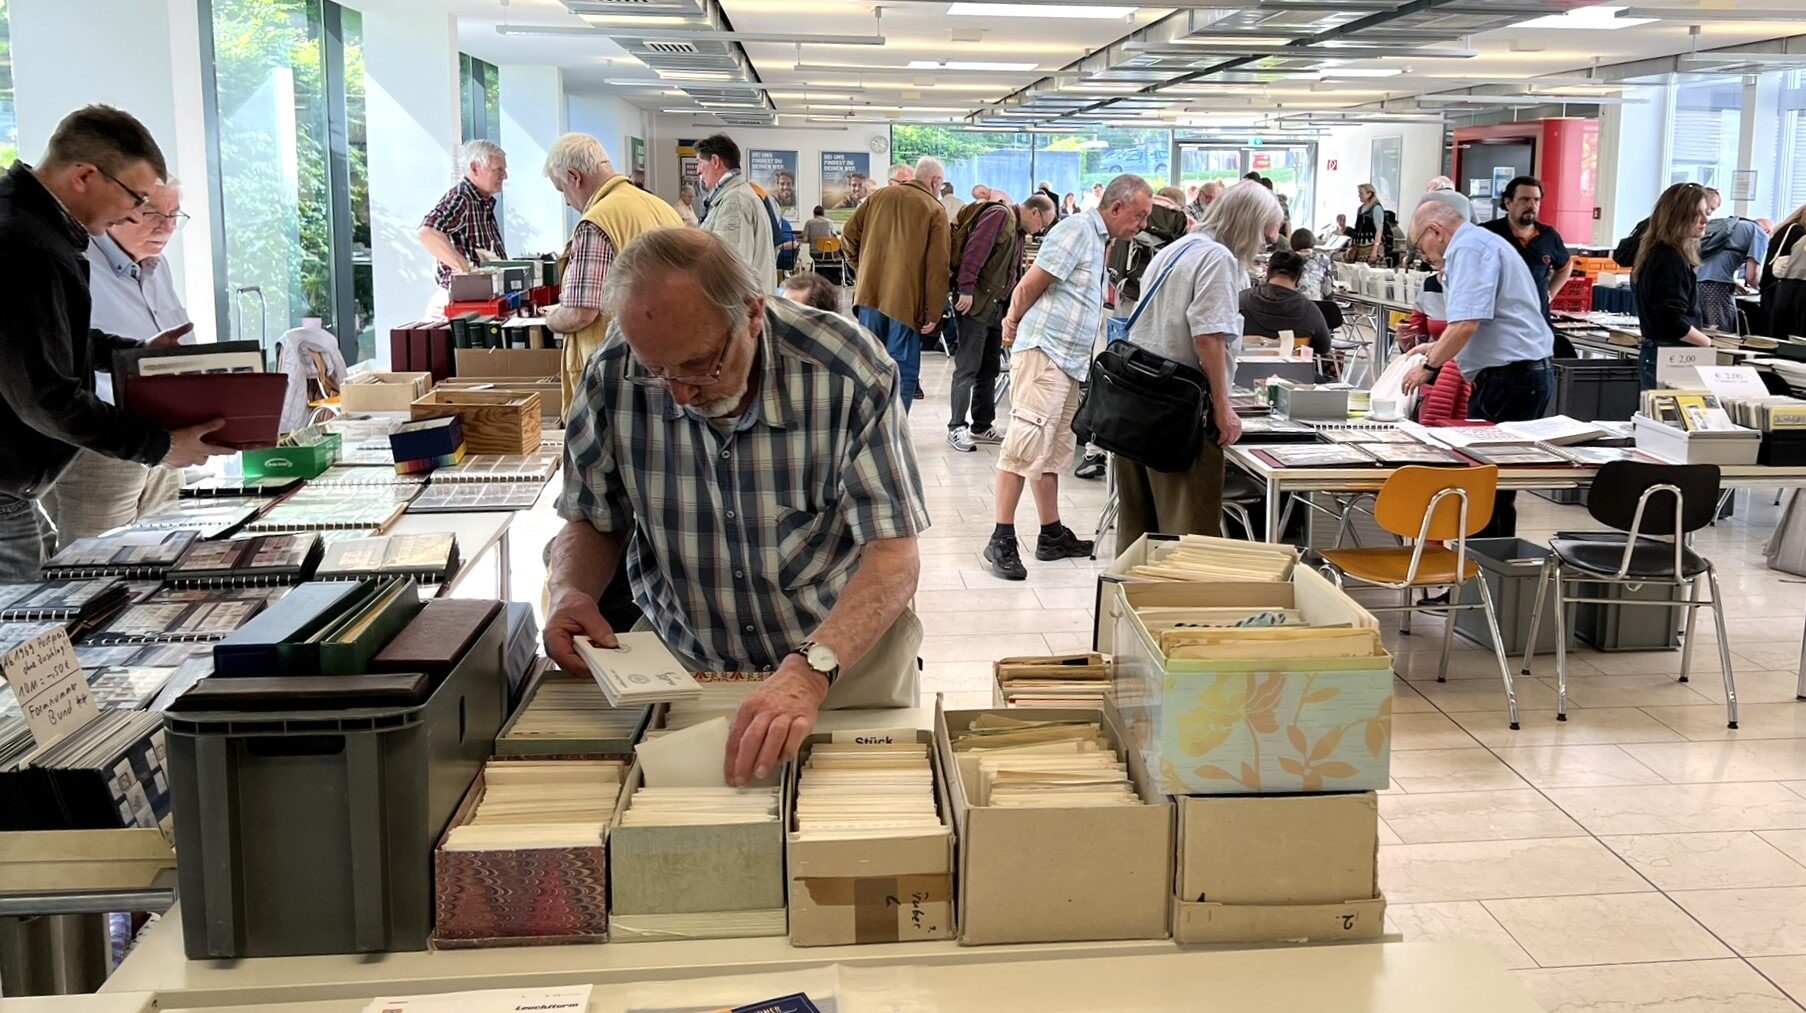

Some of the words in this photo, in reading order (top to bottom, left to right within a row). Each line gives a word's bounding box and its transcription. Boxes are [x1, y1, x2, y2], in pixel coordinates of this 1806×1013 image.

[1669, 355, 1675, 363] €
[14, 643, 34, 661] 1969
[23, 661, 37, 675] ohne
[48, 700, 73, 725] Bund
[855, 736, 893, 745] Stück
